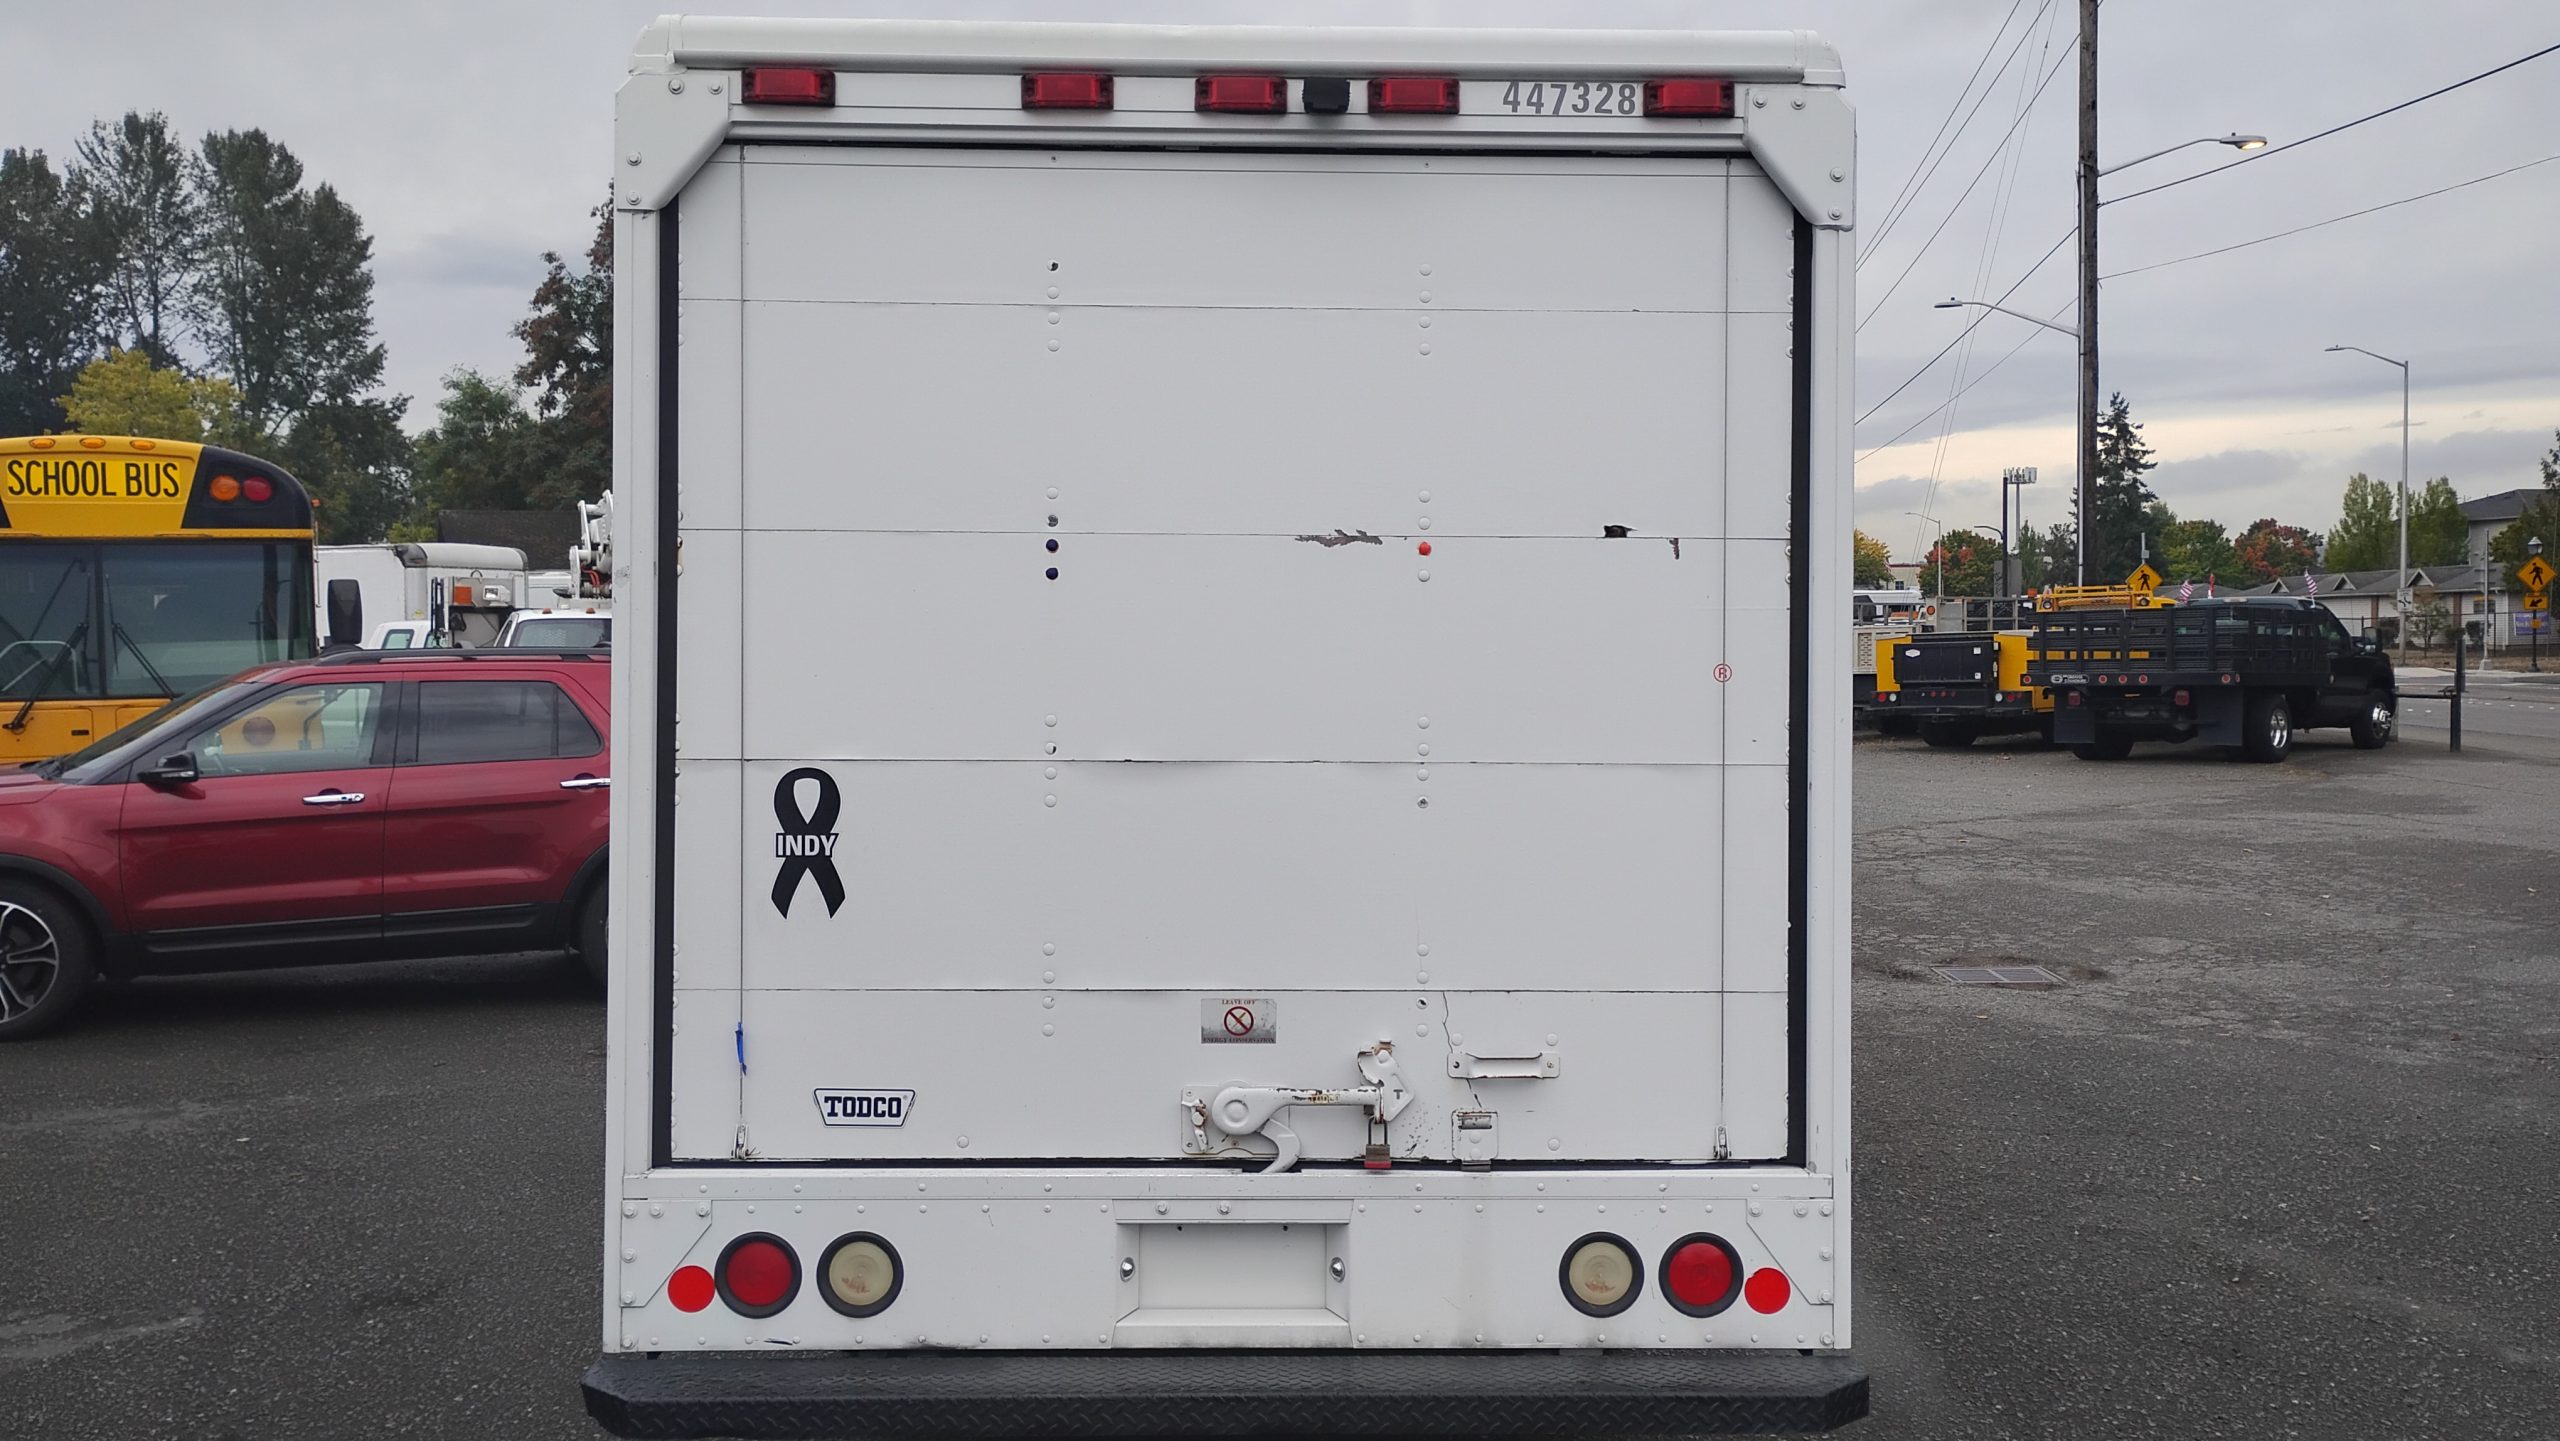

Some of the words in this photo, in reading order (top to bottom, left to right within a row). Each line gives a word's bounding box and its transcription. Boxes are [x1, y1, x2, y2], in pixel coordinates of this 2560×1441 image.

[1503, 82, 1636, 115] 447328
[7, 459, 117, 496] SCHOOL
[125, 462, 179, 497] BUS
[777, 834, 836, 856] INDY
[824, 1096, 902, 1118] TODCO
